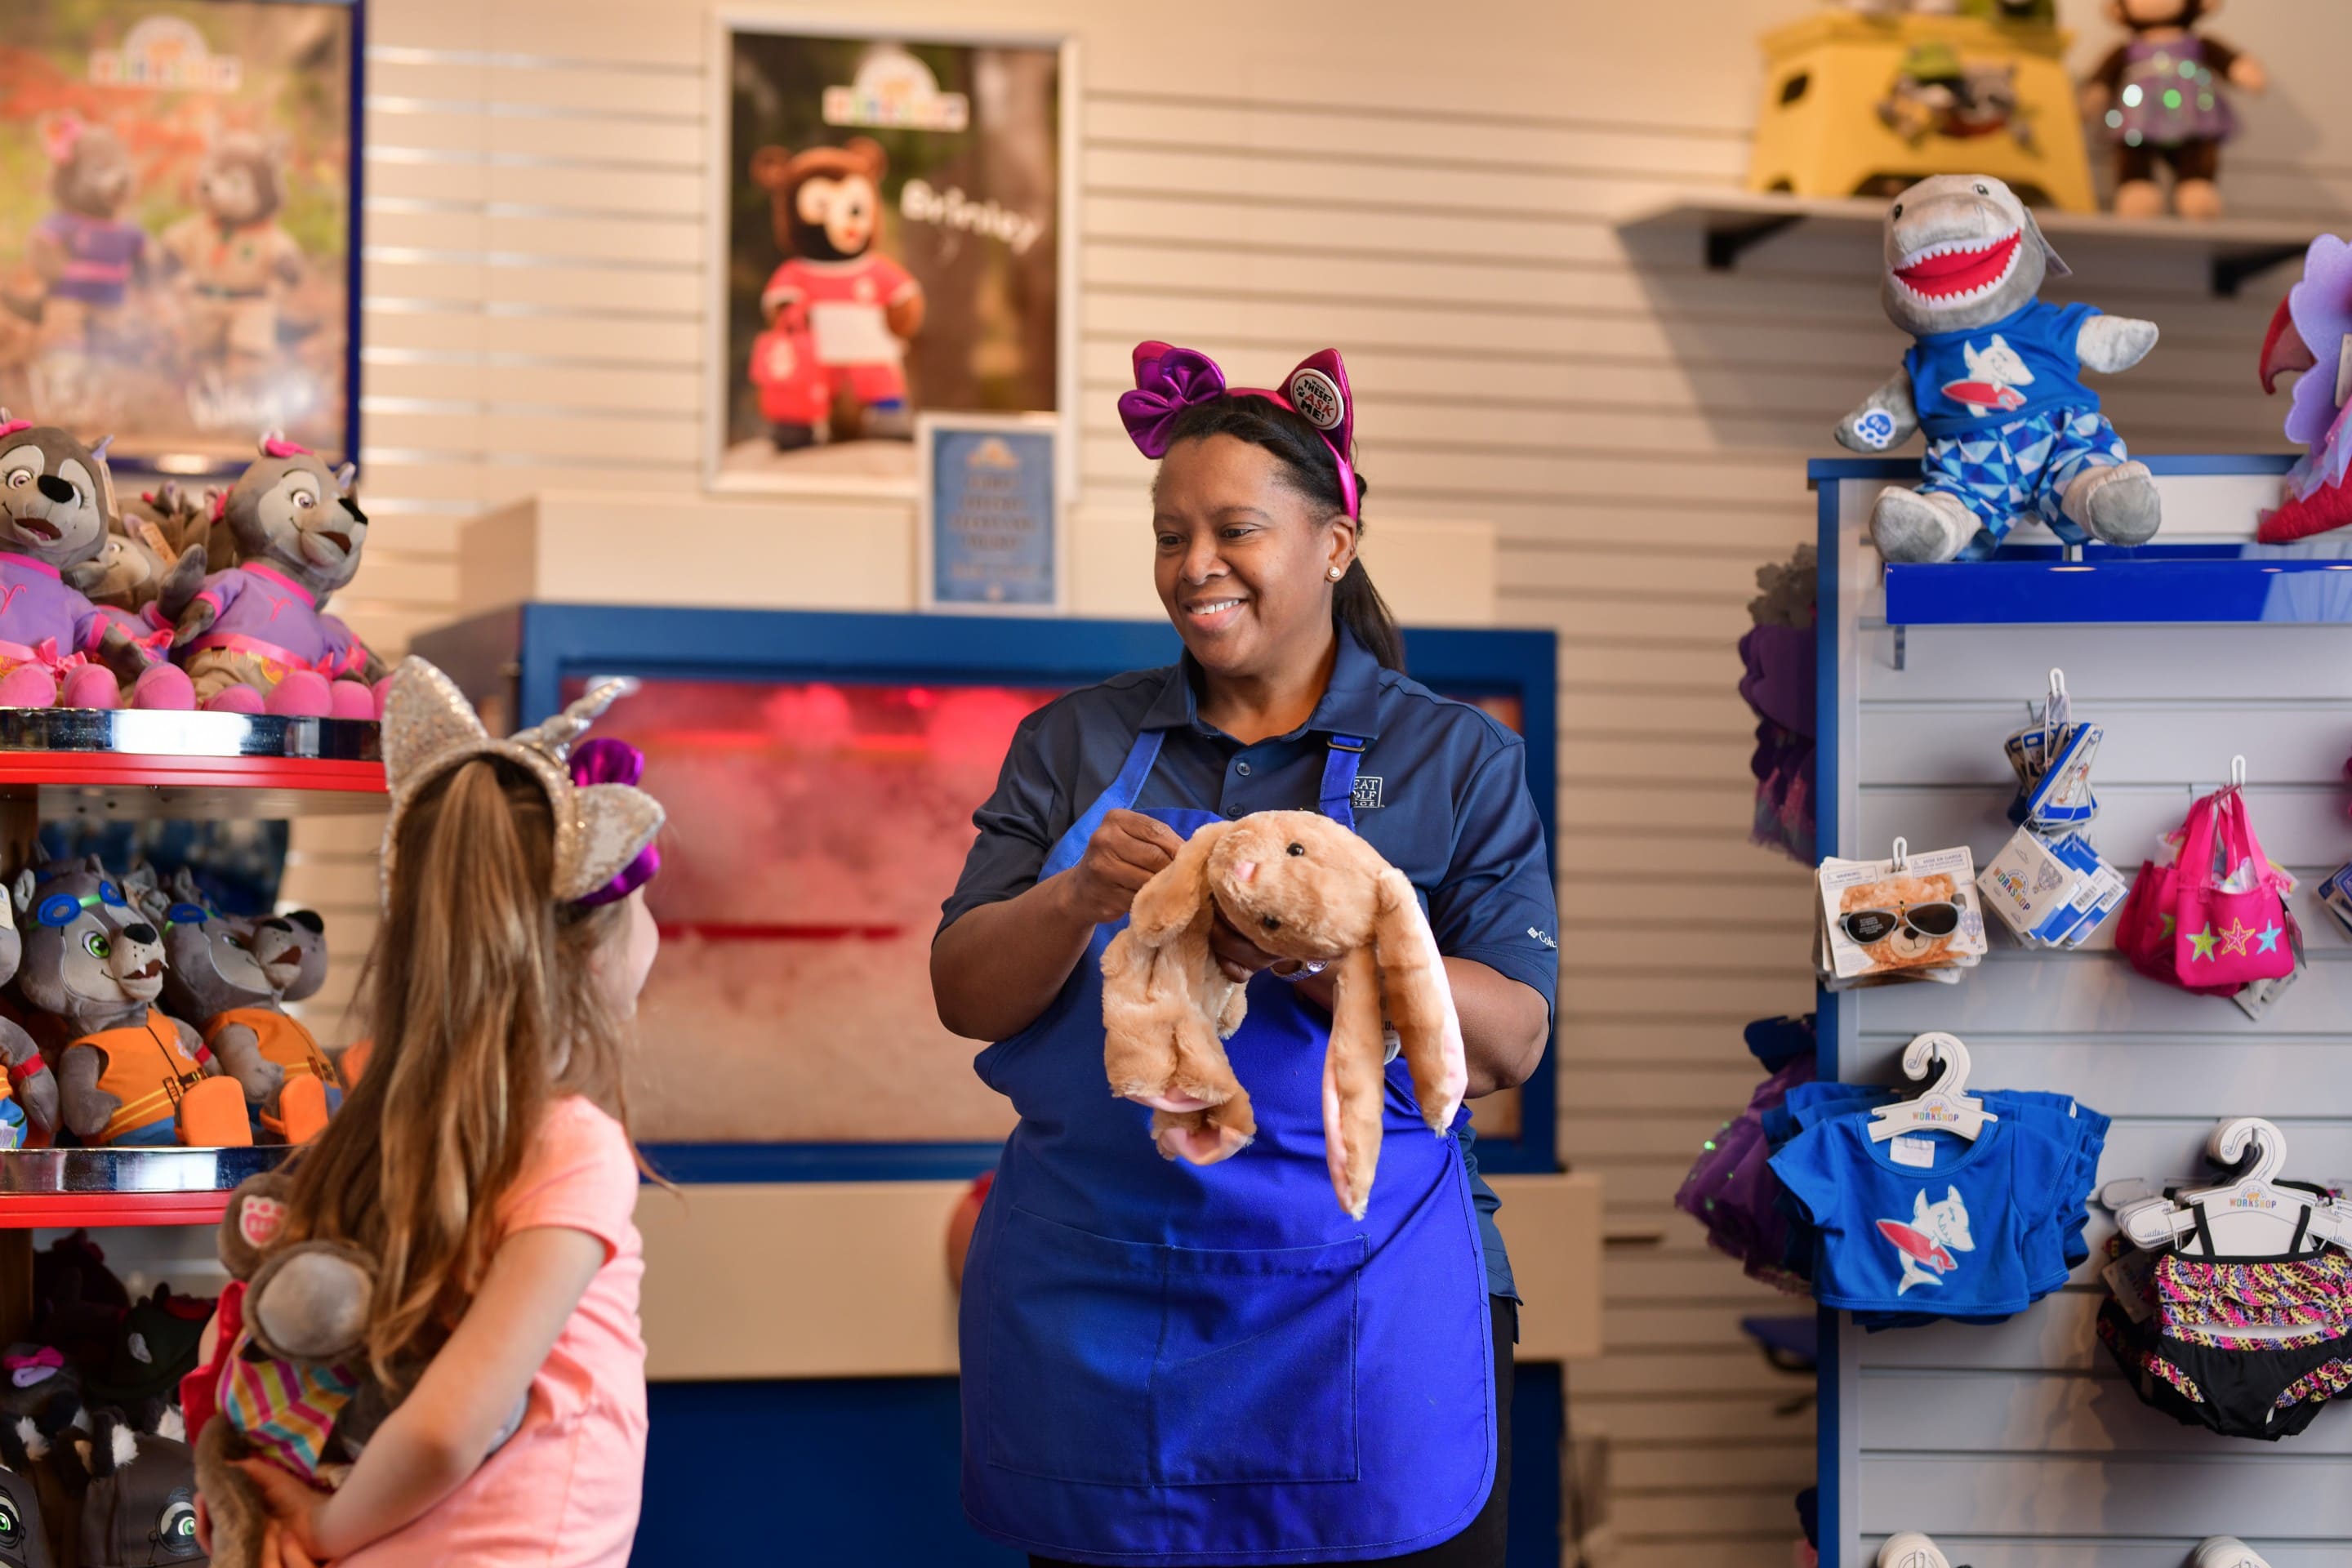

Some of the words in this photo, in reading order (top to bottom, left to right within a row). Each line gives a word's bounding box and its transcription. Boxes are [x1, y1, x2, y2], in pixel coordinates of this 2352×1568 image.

[1303, 379, 1333, 404] THESE?
[1300, 400, 1325, 422] ME!
[1304, 394, 1334, 417] ASK
[1993, 866, 2031, 911] WORKSHOP
[1912, 1111, 1959, 1122] WORKSHOP
[2229, 1197, 2277, 1209] WORKSHOP
